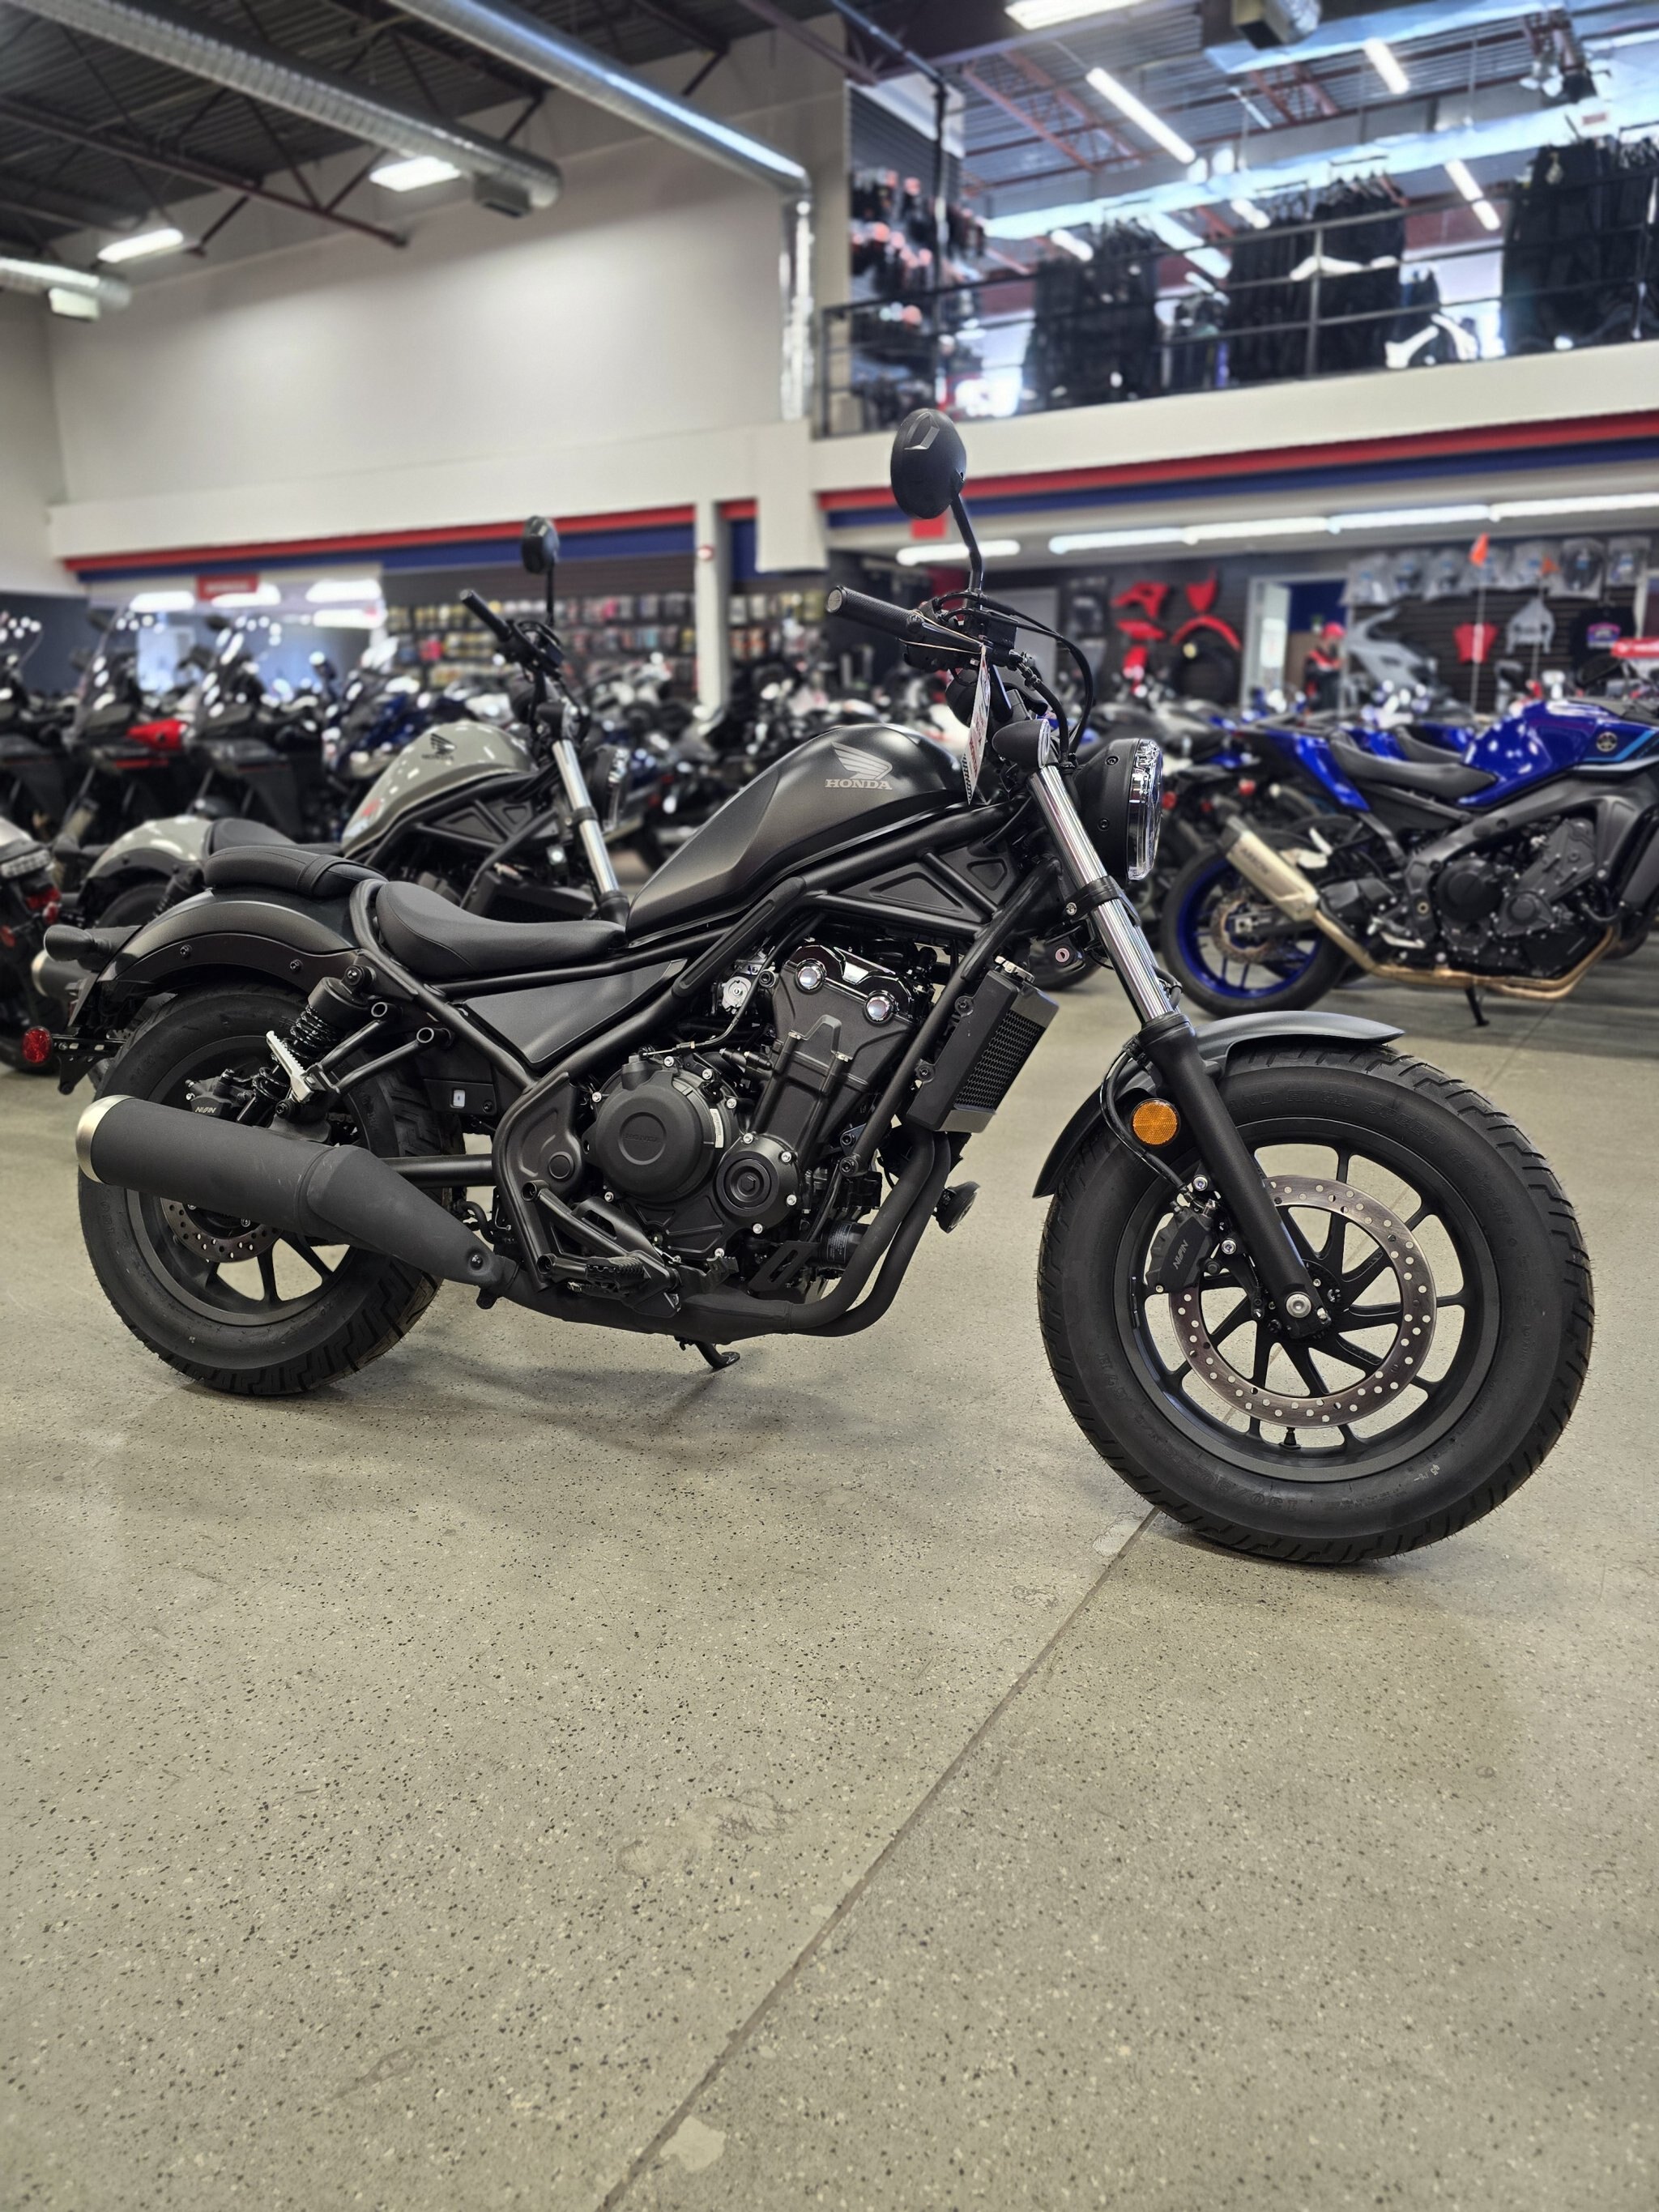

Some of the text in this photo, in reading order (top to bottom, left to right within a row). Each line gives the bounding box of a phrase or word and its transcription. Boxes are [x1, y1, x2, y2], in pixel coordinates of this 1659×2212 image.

[825, 778, 893, 791] HONDA
[1229, 1091, 1273, 1112] AND
[1286, 1089, 1354, 1108] HIGH
[1364, 1101, 1440, 1144] SPEED
[621, 1132, 662, 1144] HONDA
